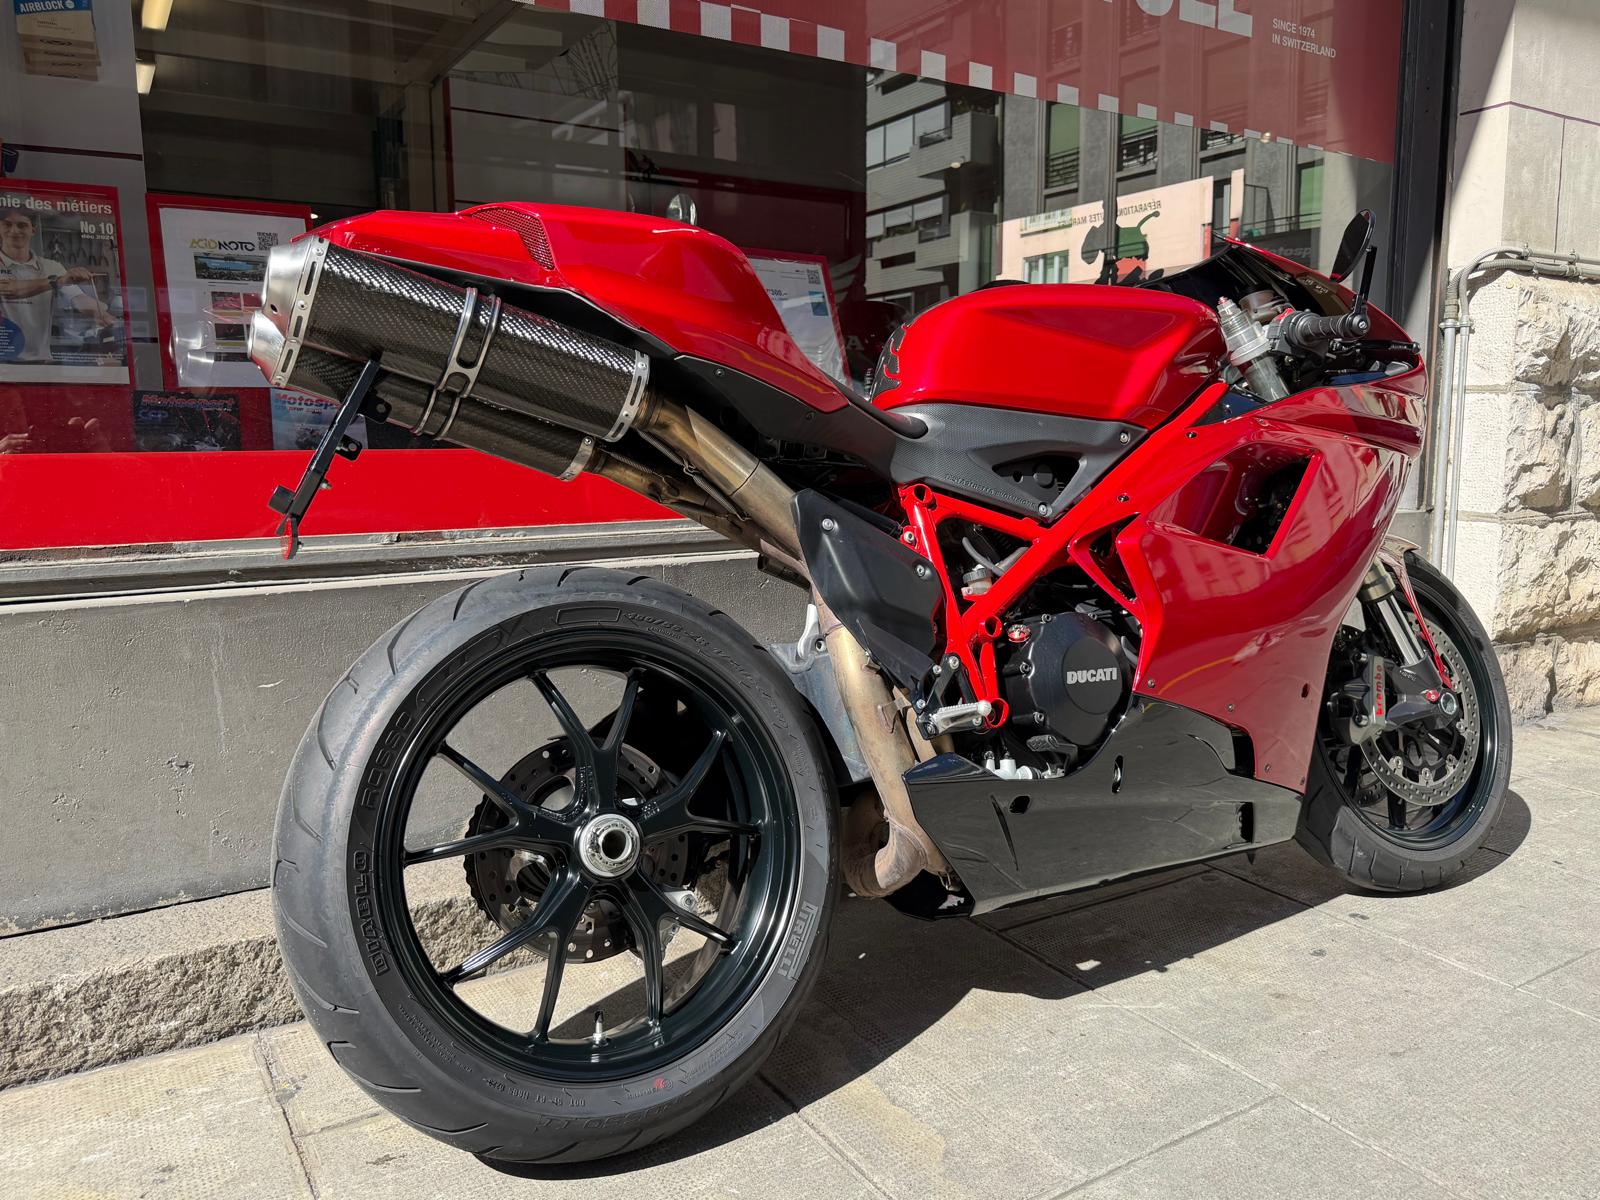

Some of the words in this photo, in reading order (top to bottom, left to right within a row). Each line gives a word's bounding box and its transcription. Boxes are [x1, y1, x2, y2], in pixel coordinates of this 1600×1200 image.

[20, 0, 65, 13] AIRBLOCK
[1272, 18, 1297, 34] SINCE
[1299, 25, 1316, 39] 1974
[1272, 34, 1281, 46] IN
[1282, 36, 1337, 59] SWITZERLAND
[25, 197, 52, 210] des
[57, 199, 112, 214] métiers
[80, 221, 96, 234] No
[99, 222, 114, 235] 10
[1066, 667, 1118, 685] DUCATI
[1375, 664, 1384, 717] brembo
[361, 711, 412, 809] ROSSO
[353, 851, 390, 976] DIABLO
[777, 900, 820, 980] PIRELLI
